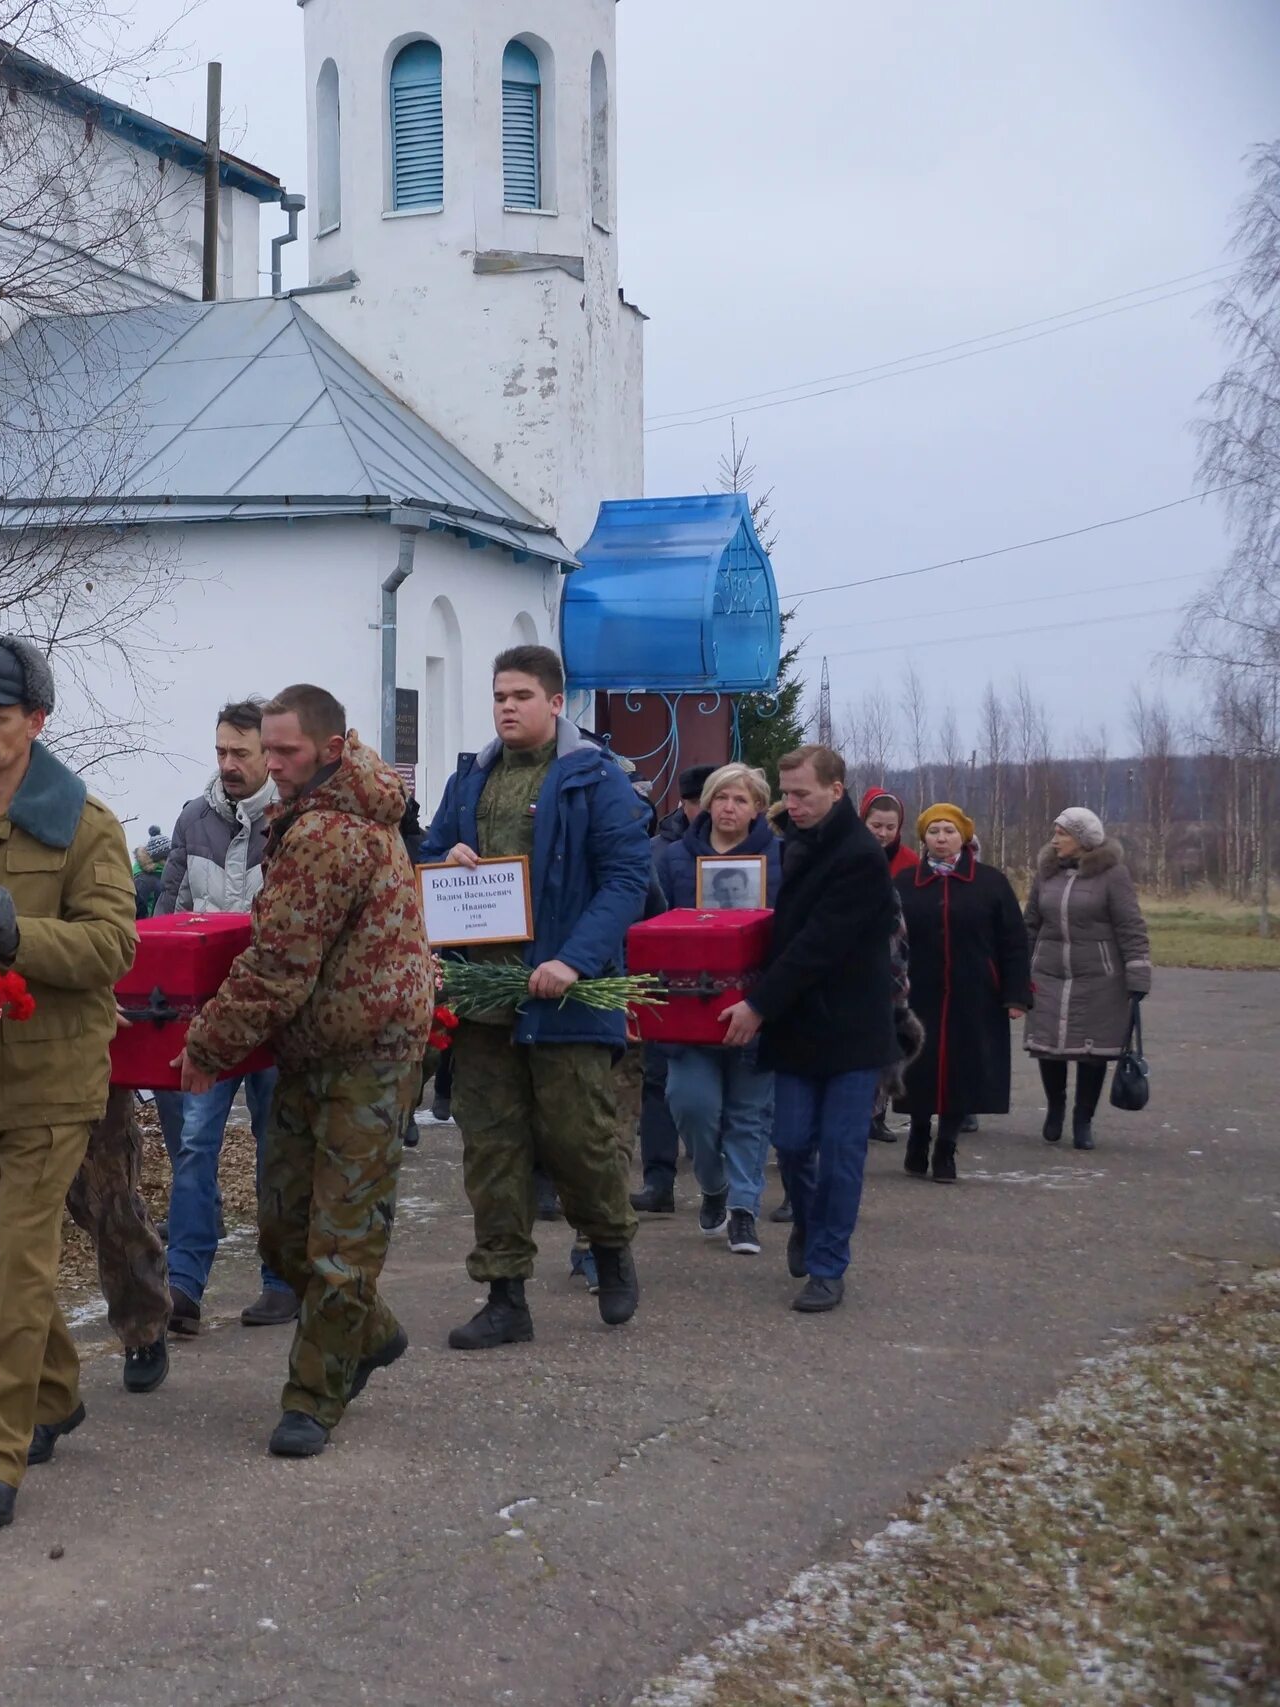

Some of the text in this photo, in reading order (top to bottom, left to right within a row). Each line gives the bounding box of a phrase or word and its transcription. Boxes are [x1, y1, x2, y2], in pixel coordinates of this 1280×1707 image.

[432, 872, 515, 889] БОЛЬШАКОВ
[436, 889, 512, 902] Вадим Васильевич
[461, 902, 497, 912] Иваново
